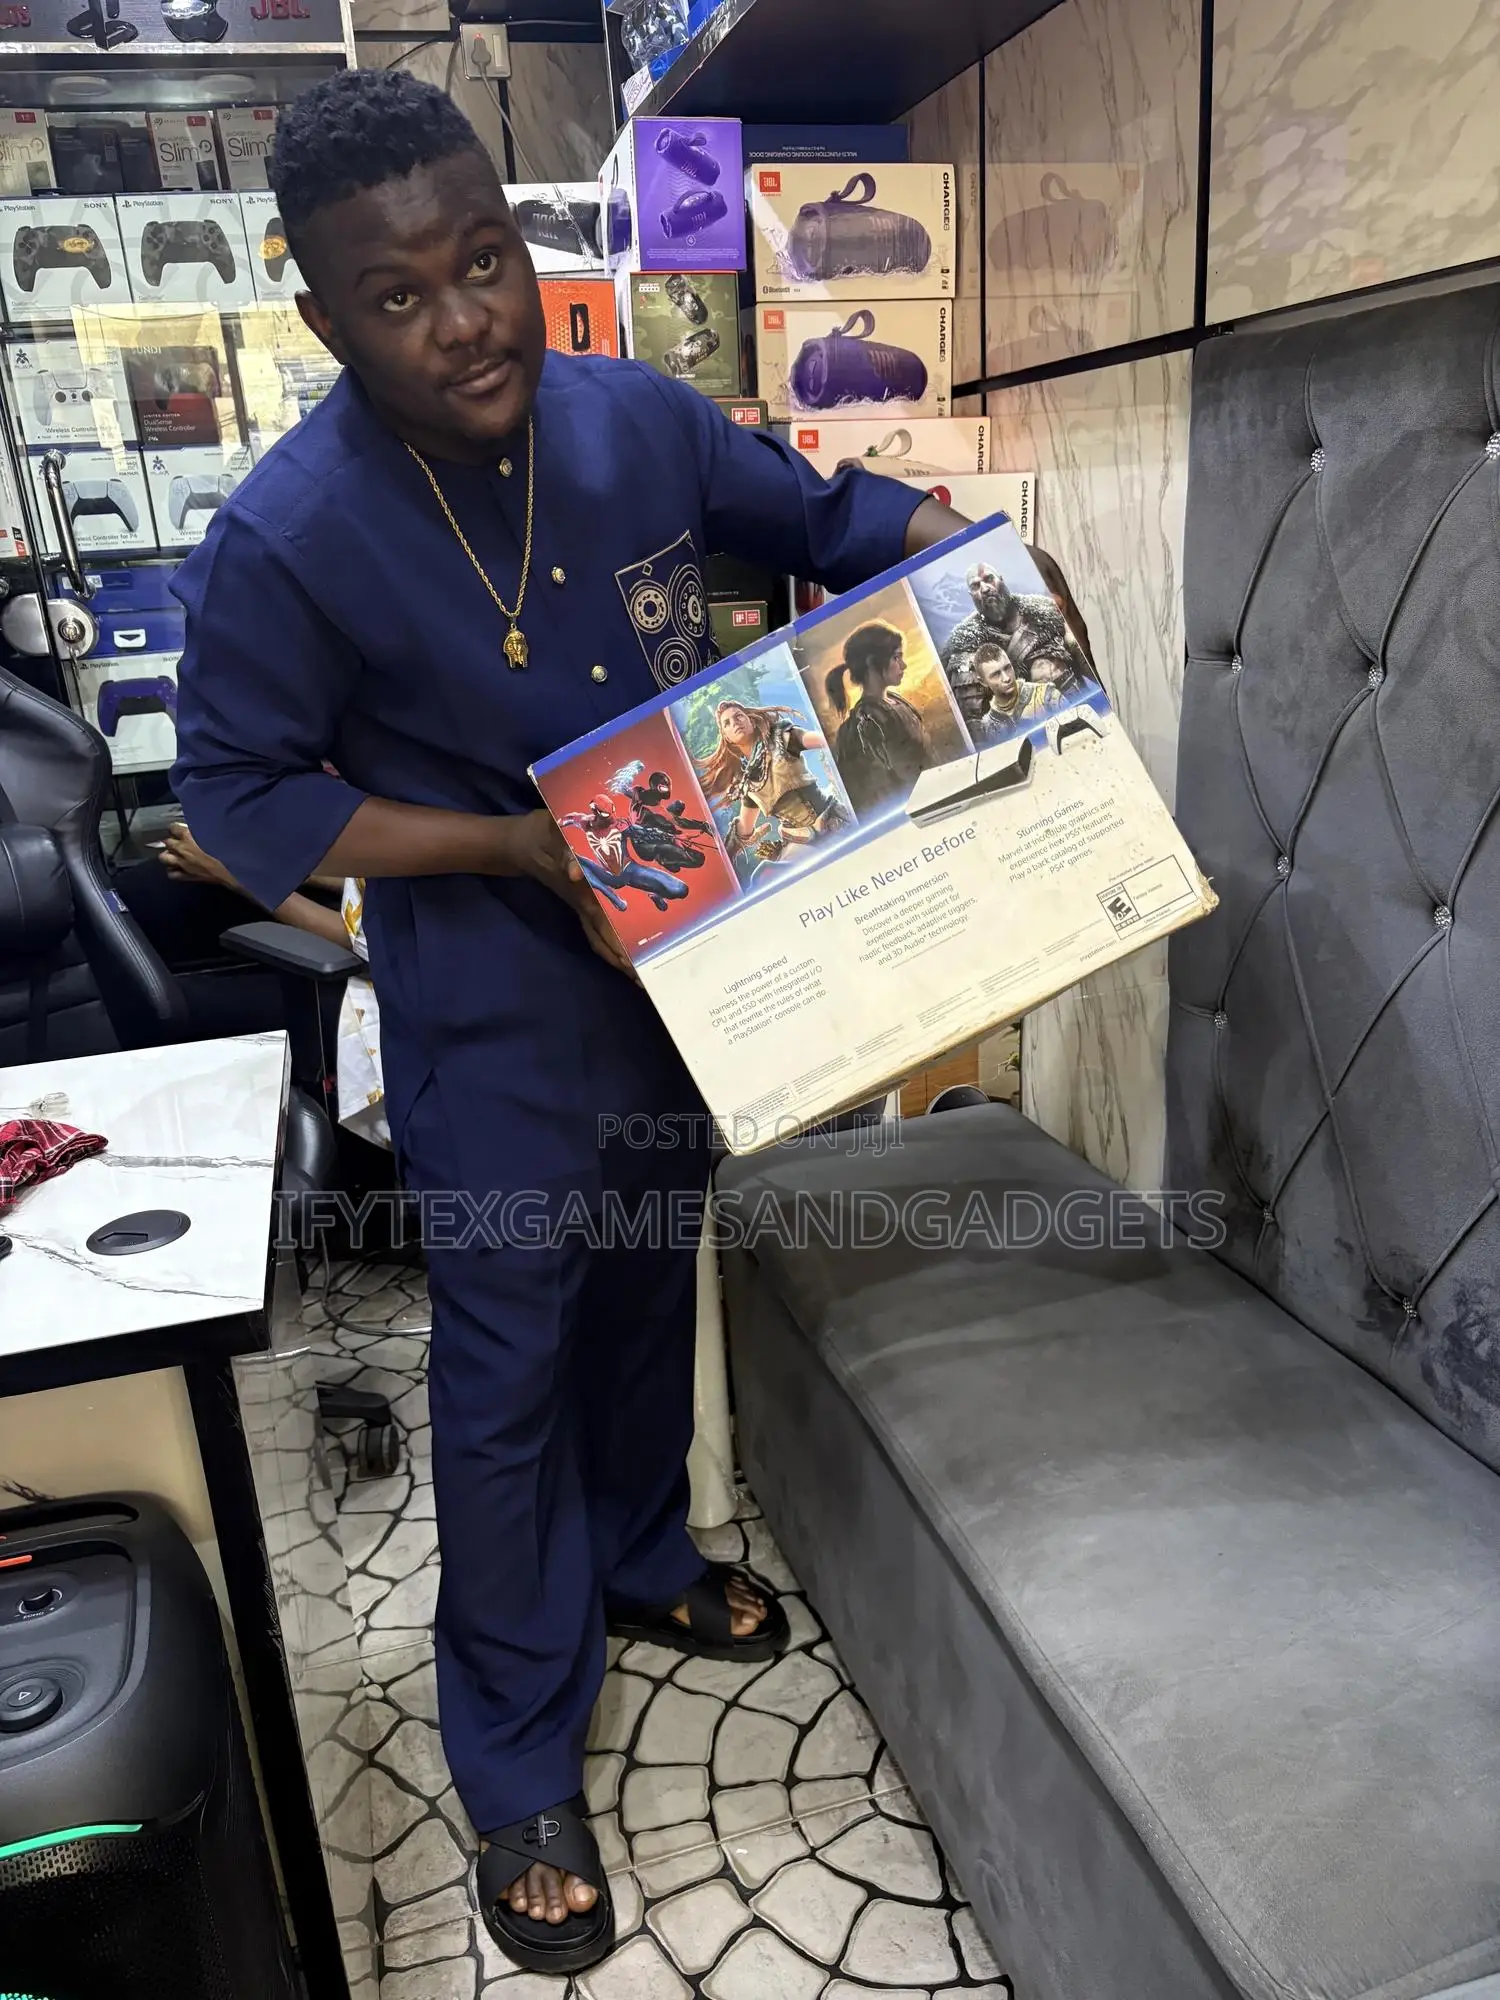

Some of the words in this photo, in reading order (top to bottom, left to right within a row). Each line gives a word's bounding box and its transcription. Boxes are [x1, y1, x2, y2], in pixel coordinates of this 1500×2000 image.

[0, 140, 31, 161] lim
[160, 142, 200, 162] Slim
[228, 137, 268, 157] Slim
[763, 176, 778, 188] JBL
[768, 315, 782, 325] JBL
[802, 434, 816, 445] JBL
[998, 846, 1024, 863] Marvel
[1024, 842, 1033, 850] at
[1032, 824, 1068, 845] incredible
[1069, 807, 1100, 826] graphics
[1100, 798, 1115, 809] and
[1010, 847, 1048, 870] experience
[1082, 813, 1113, 831] features
[1016, 816, 1055, 838] Stunning
[1054, 800, 1085, 818] Games
[1009, 871, 1026, 882] Play
[1032, 858, 1050, 871] back
[1051, 844, 1078, 861] catalog
[1078, 838, 1087, 846] of
[1087, 818, 1125, 841] supported
[799, 903, 834, 927] Play
[836, 885, 870, 908] Like
[871, 857, 919, 889] Never
[854, 895, 907, 924] Breathtaking
[905, 872, 950, 897] Immersion
[862, 917, 893, 936] Discover
[900, 900, 925, 916] deeper
[926, 885, 954, 903] gaming
[859, 948, 881, 962] haptic
[918, 913, 947, 932] adaptive
[866, 923, 904, 946] experience
[905, 914, 921, 925] with
[922, 899, 950, 917] support
[949, 893, 960, 901] for
[724, 971, 763, 994] Lightning
[762, 956, 788, 974] Speed
[878, 954, 893, 965] and
[893, 948, 904, 957] 3D
[709, 1000, 739, 1016] Harness
[738, 992, 751, 1001] the
[751, 980, 773, 996] power
[774, 974, 783, 982] of
[789, 958, 816, 975] custom
[712, 1016, 727, 1027] CPU
[729, 1008, 743, 1020] and
[742, 1001, 757, 1012] SSD
[757, 993, 774, 1004] with
[774, 973, 810, 994] integrated
[810, 965, 823, 975] I/O
[723, 1023, 739, 1034] that
[739, 1011, 763, 1025] rewrite
[763, 1004, 776, 1013] the
[777, 994, 795, 1006] rules
[795, 988, 803, 997] of
[804, 979, 822, 991] what
[775, 1003, 802, 1020] console
[802, 996, 816, 1005] can
